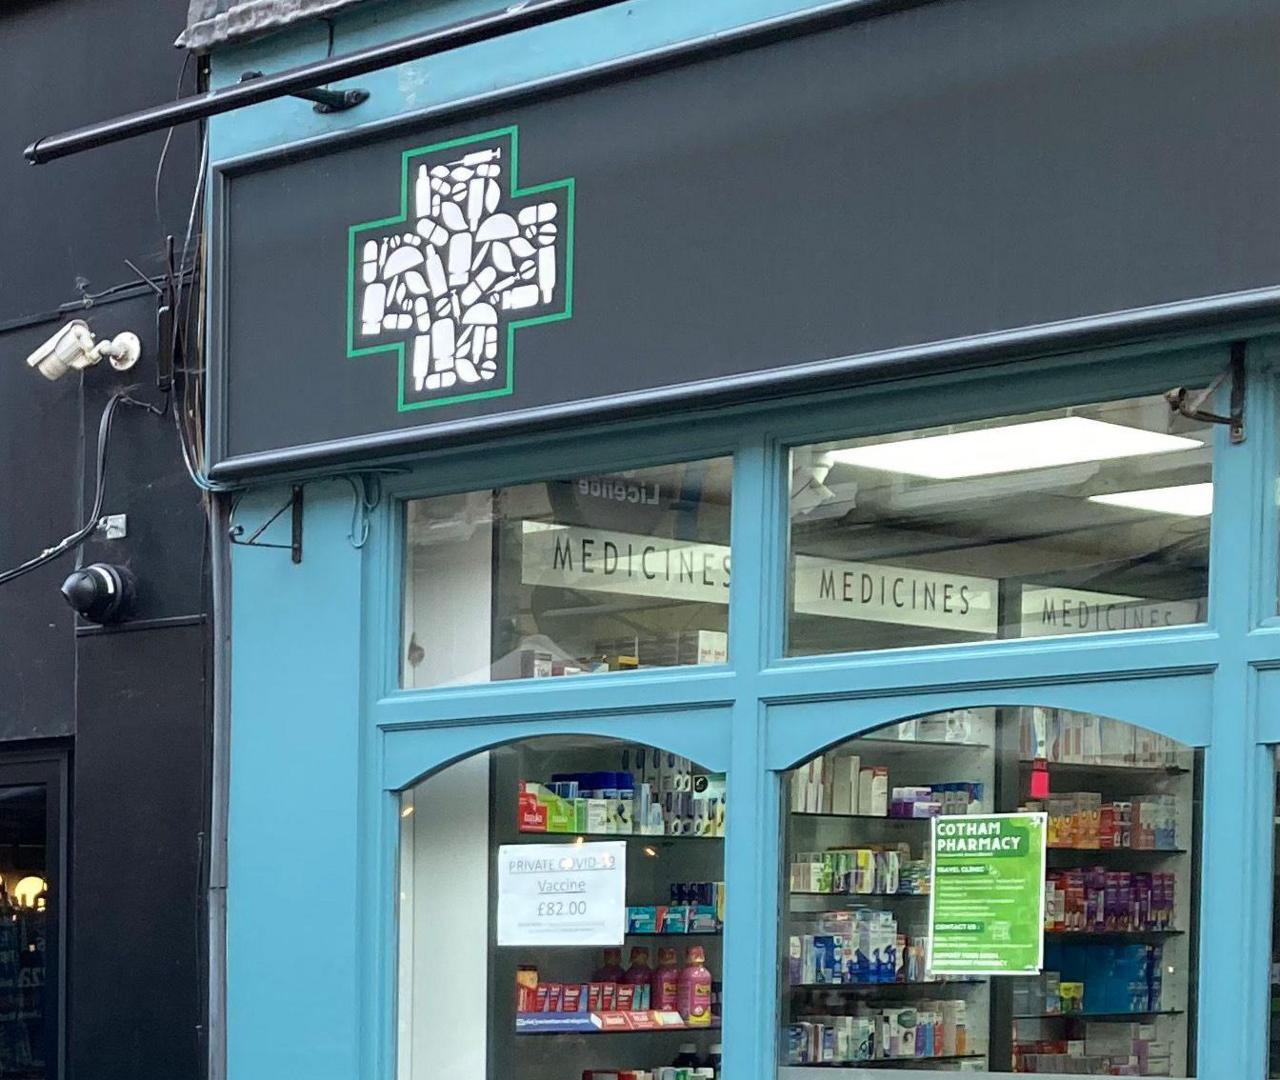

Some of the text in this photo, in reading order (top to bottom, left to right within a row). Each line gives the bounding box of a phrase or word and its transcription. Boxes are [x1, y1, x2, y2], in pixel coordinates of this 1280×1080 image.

[553, 536, 731, 588] MEDICINES
[819, 568, 970, 615] MEDICINES
[937, 822, 1000, 836] COTHAM
[937, 836, 1021, 851] PHARMACY
[509, 858, 554, 872] PRIVATE
[537, 879, 587, 892] Vaccine
